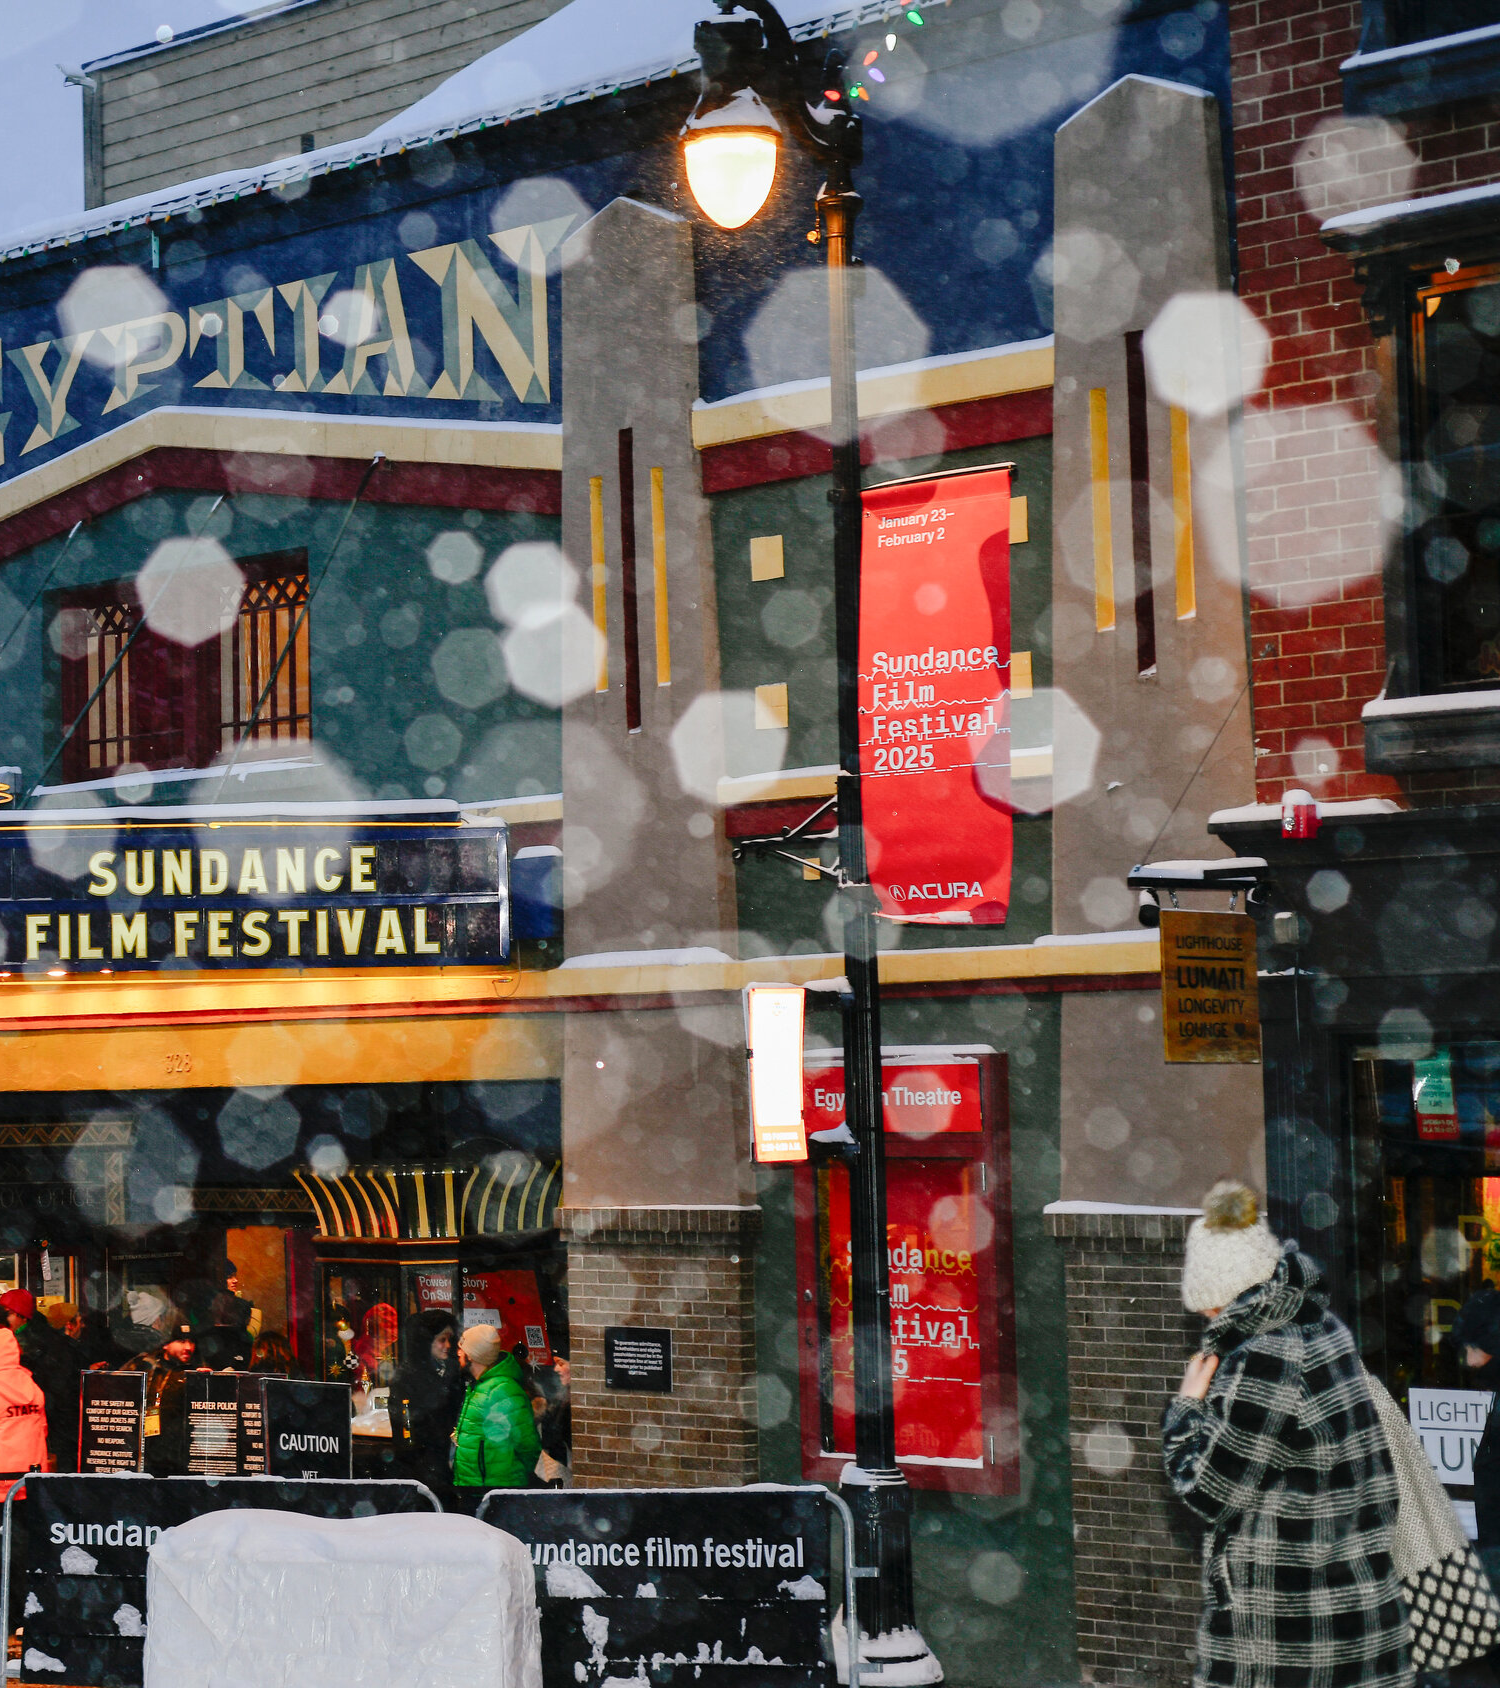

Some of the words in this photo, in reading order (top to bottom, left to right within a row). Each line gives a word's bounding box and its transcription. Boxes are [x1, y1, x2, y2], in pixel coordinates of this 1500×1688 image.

[878, 511, 929, 531] January
[877, 530, 934, 548] February
[936, 527, 945, 540] 2
[872, 645, 998, 673] Sundance
[873, 680, 935, 706] Film
[873, 705, 995, 738] Festival
[873, 744, 935, 772] 2025
[87, 845, 377, 897] SUNDANCE
[908, 881, 983, 900] ACURA
[25, 911, 148, 961] FILM
[174, 907, 441, 958] FESTIVAL
[1175, 935, 1243, 951] LIGHTHOUSE
[1177, 965, 1245, 990] LUMATI
[1179, 997, 1245, 1015] LONGEVITY
[1179, 1021, 1228, 1038] LOUNGE
[164, 1054, 193, 1073] 328
[814, 1087, 888, 1111] Egyn
[891, 1086, 962, 1105] Theatre
[418, 1275, 448, 1287] Power
[422, 1289, 437, 1301] On
[7, 1404, 40, 1418] STAFF
[191, 1401, 216, 1410] THEATER
[280, 1433, 339, 1453] CAUTION
[302, 1470, 318, 1479] WET
[525, 1538, 640, 1567] undance
[645, 1537, 698, 1567] film
[703, 1537, 804, 1568] festival
